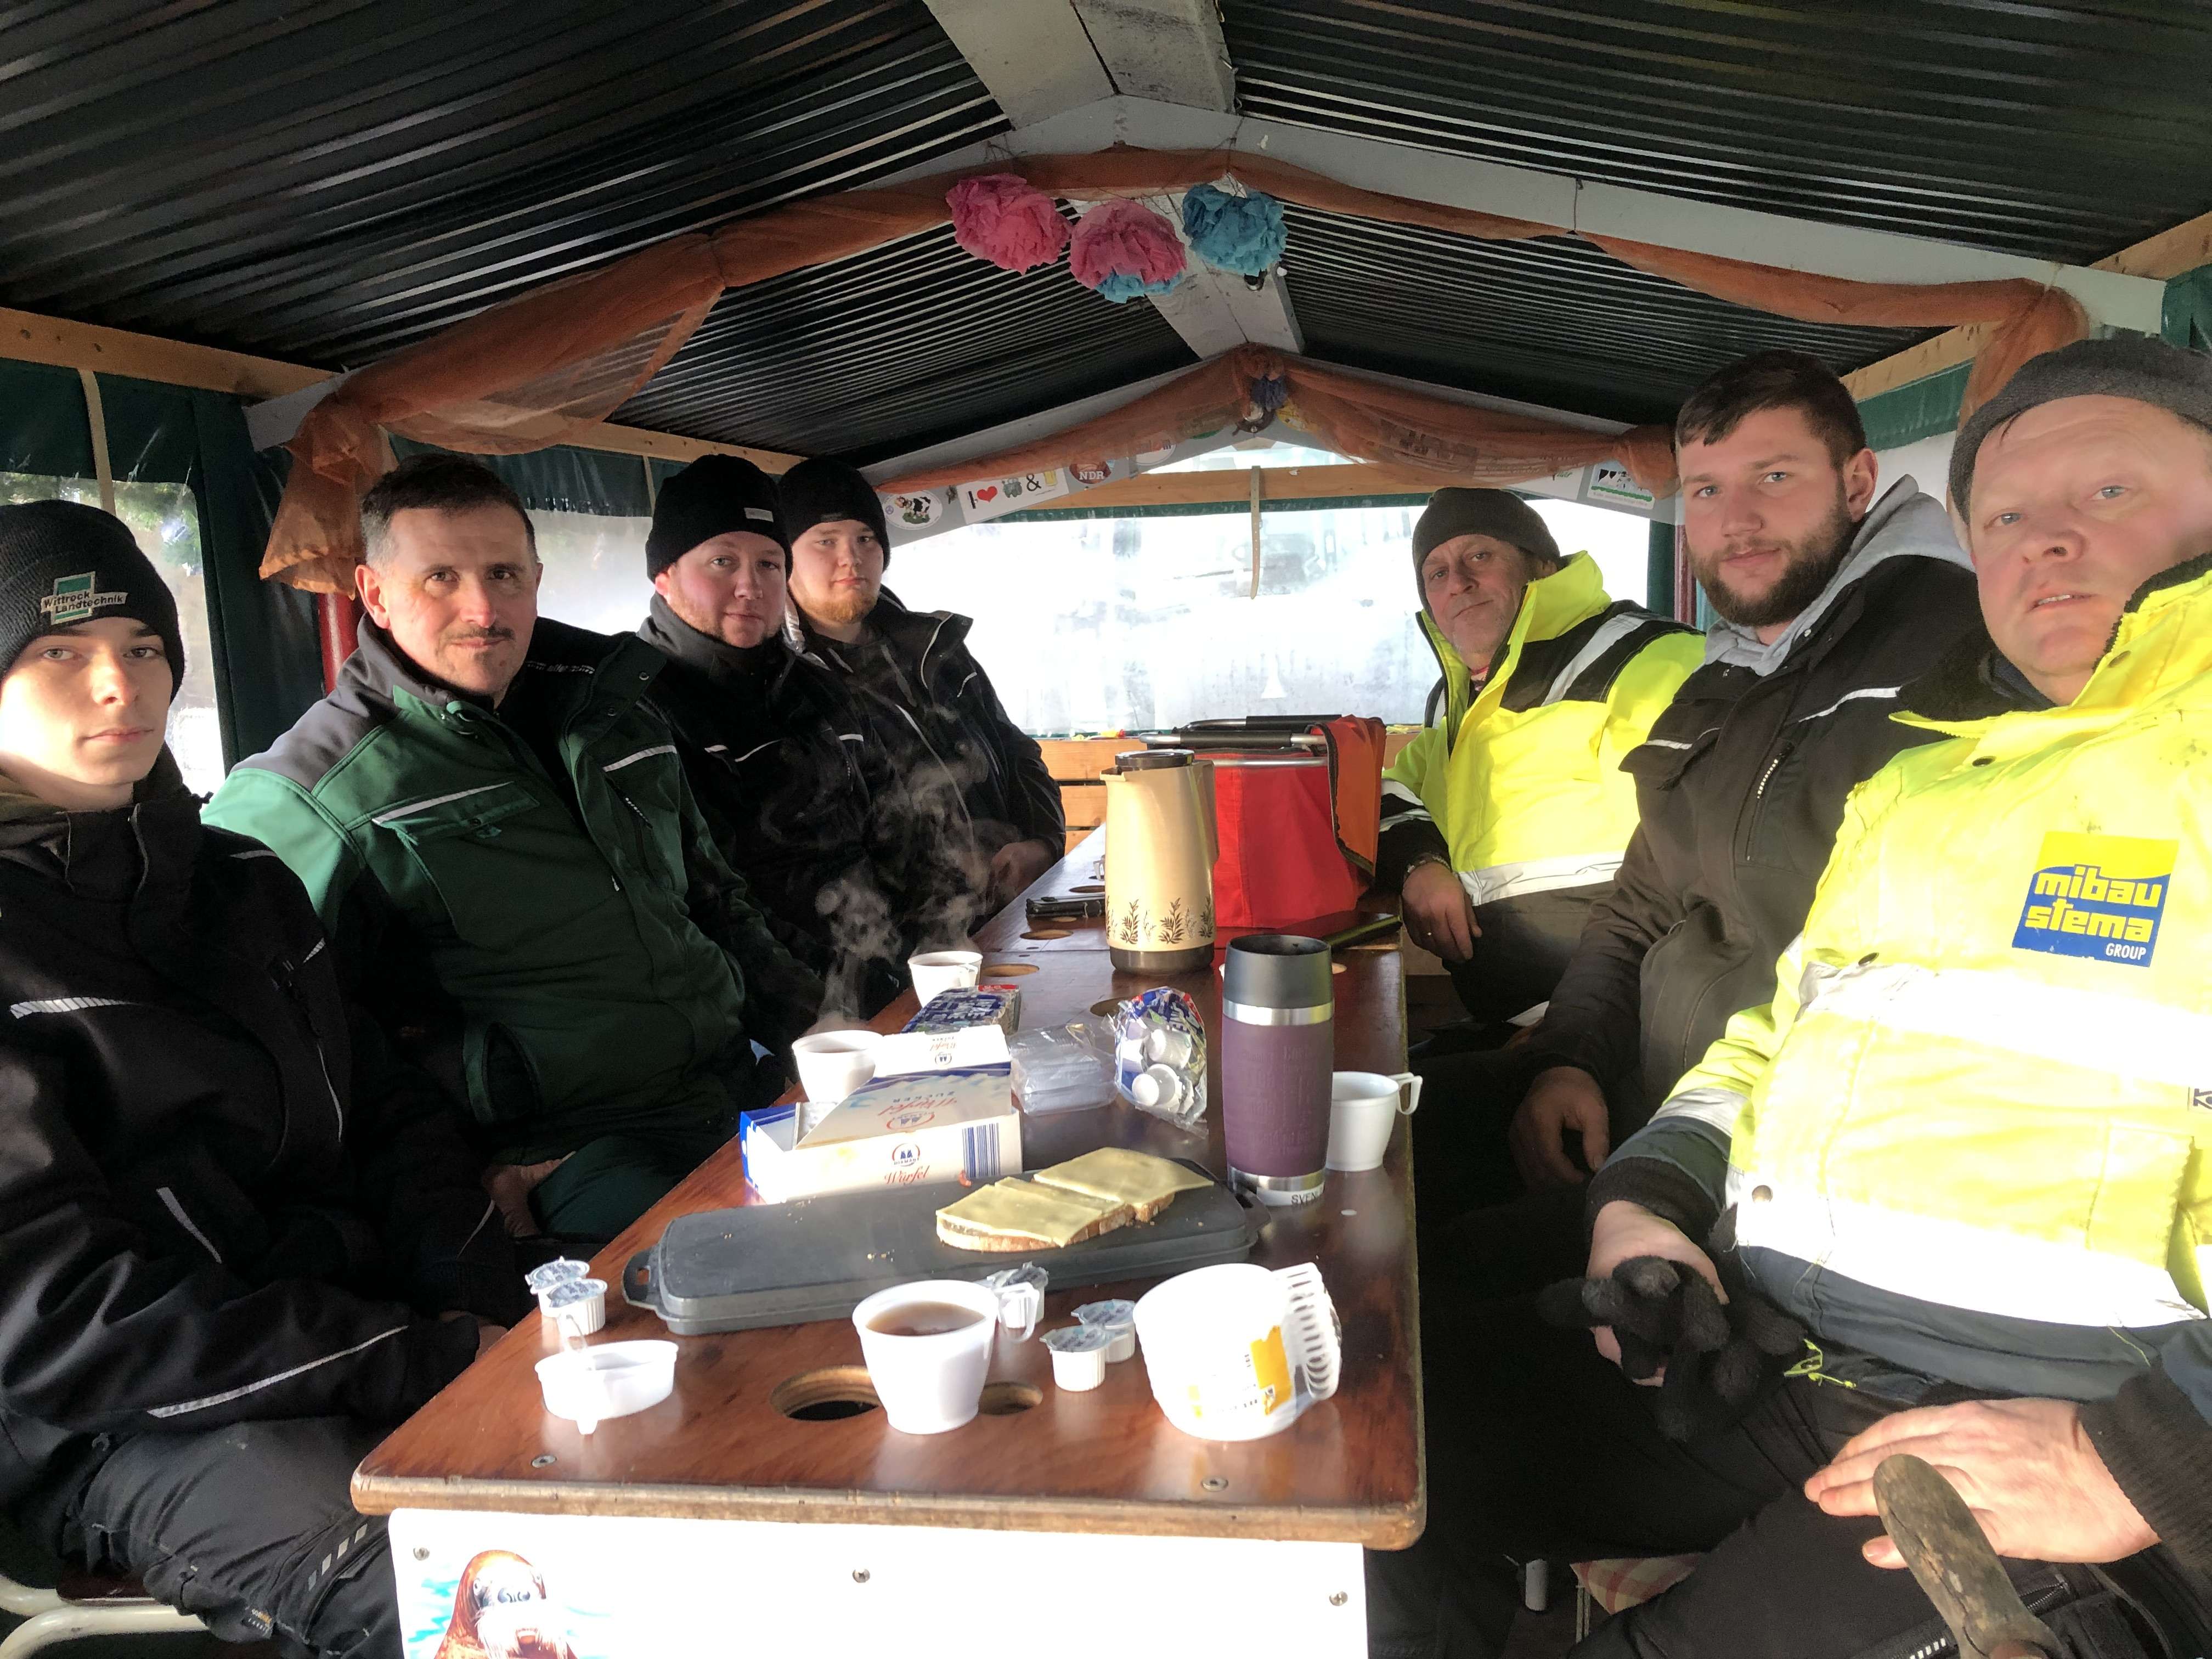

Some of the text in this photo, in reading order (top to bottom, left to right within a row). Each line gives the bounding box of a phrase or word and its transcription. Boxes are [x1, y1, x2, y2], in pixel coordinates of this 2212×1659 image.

[1079, 471, 1104, 480] NDR
[43, 591, 91, 608] Wittrock
[55, 594, 123, 613] Landtechnik
[2034, 865, 2163, 908] mibau
[2024, 898, 2154, 944] stema
[2105, 943, 2147, 961] GROUP
[884, 1165, 930, 1186] Würfel
